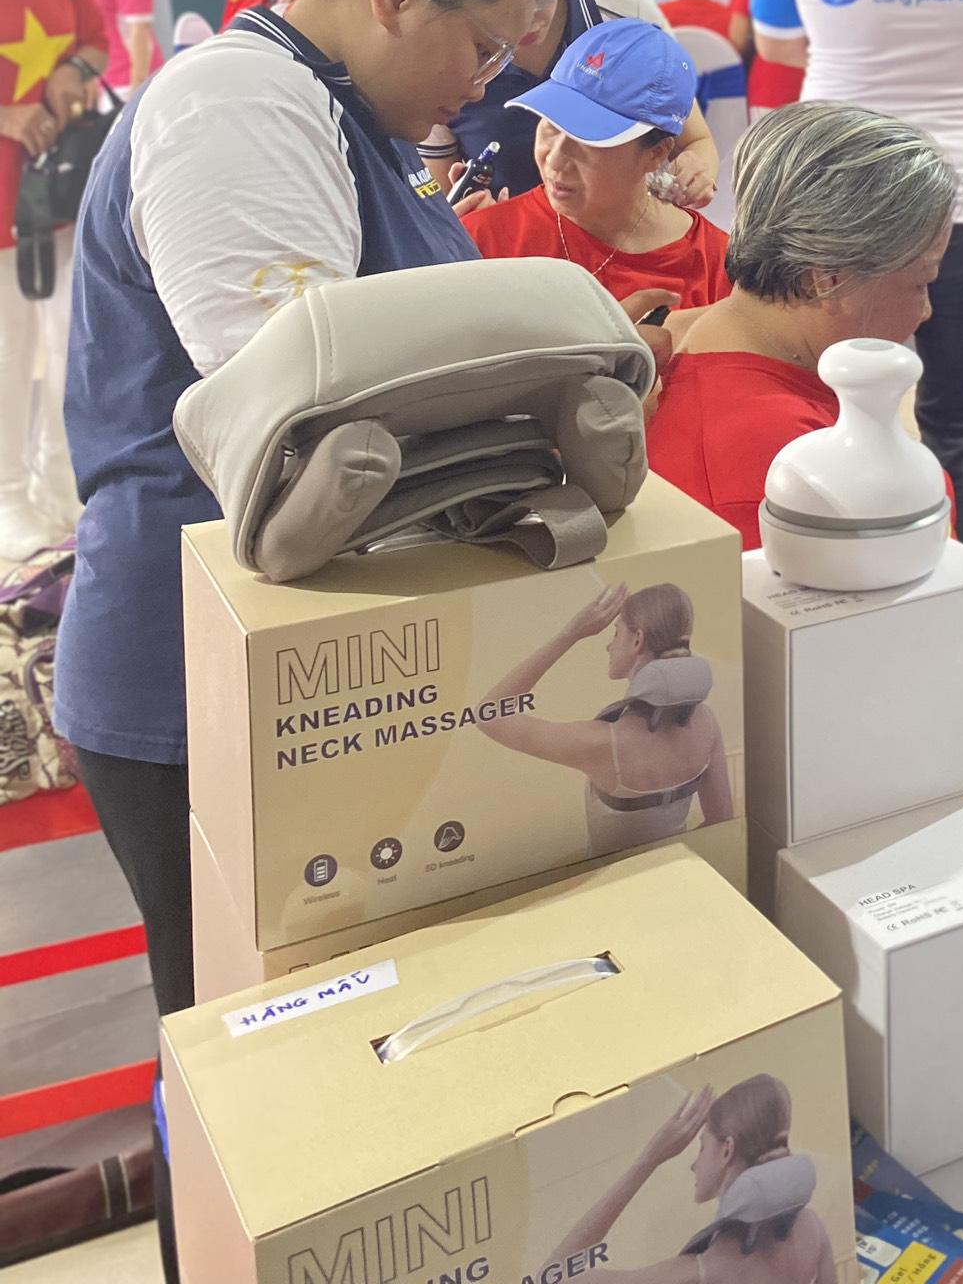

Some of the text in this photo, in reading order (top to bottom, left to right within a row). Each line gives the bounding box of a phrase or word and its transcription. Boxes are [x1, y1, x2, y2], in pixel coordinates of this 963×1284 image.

[276, 618, 440, 706] MINI
[275, 683, 439, 738] KNEADING
[276, 691, 536, 770] NECK MASSAGER
[303, 889, 341, 906] Wireless
[857, 884, 917, 907] HEAD SPA
[900, 911, 933, 927] RoHS
